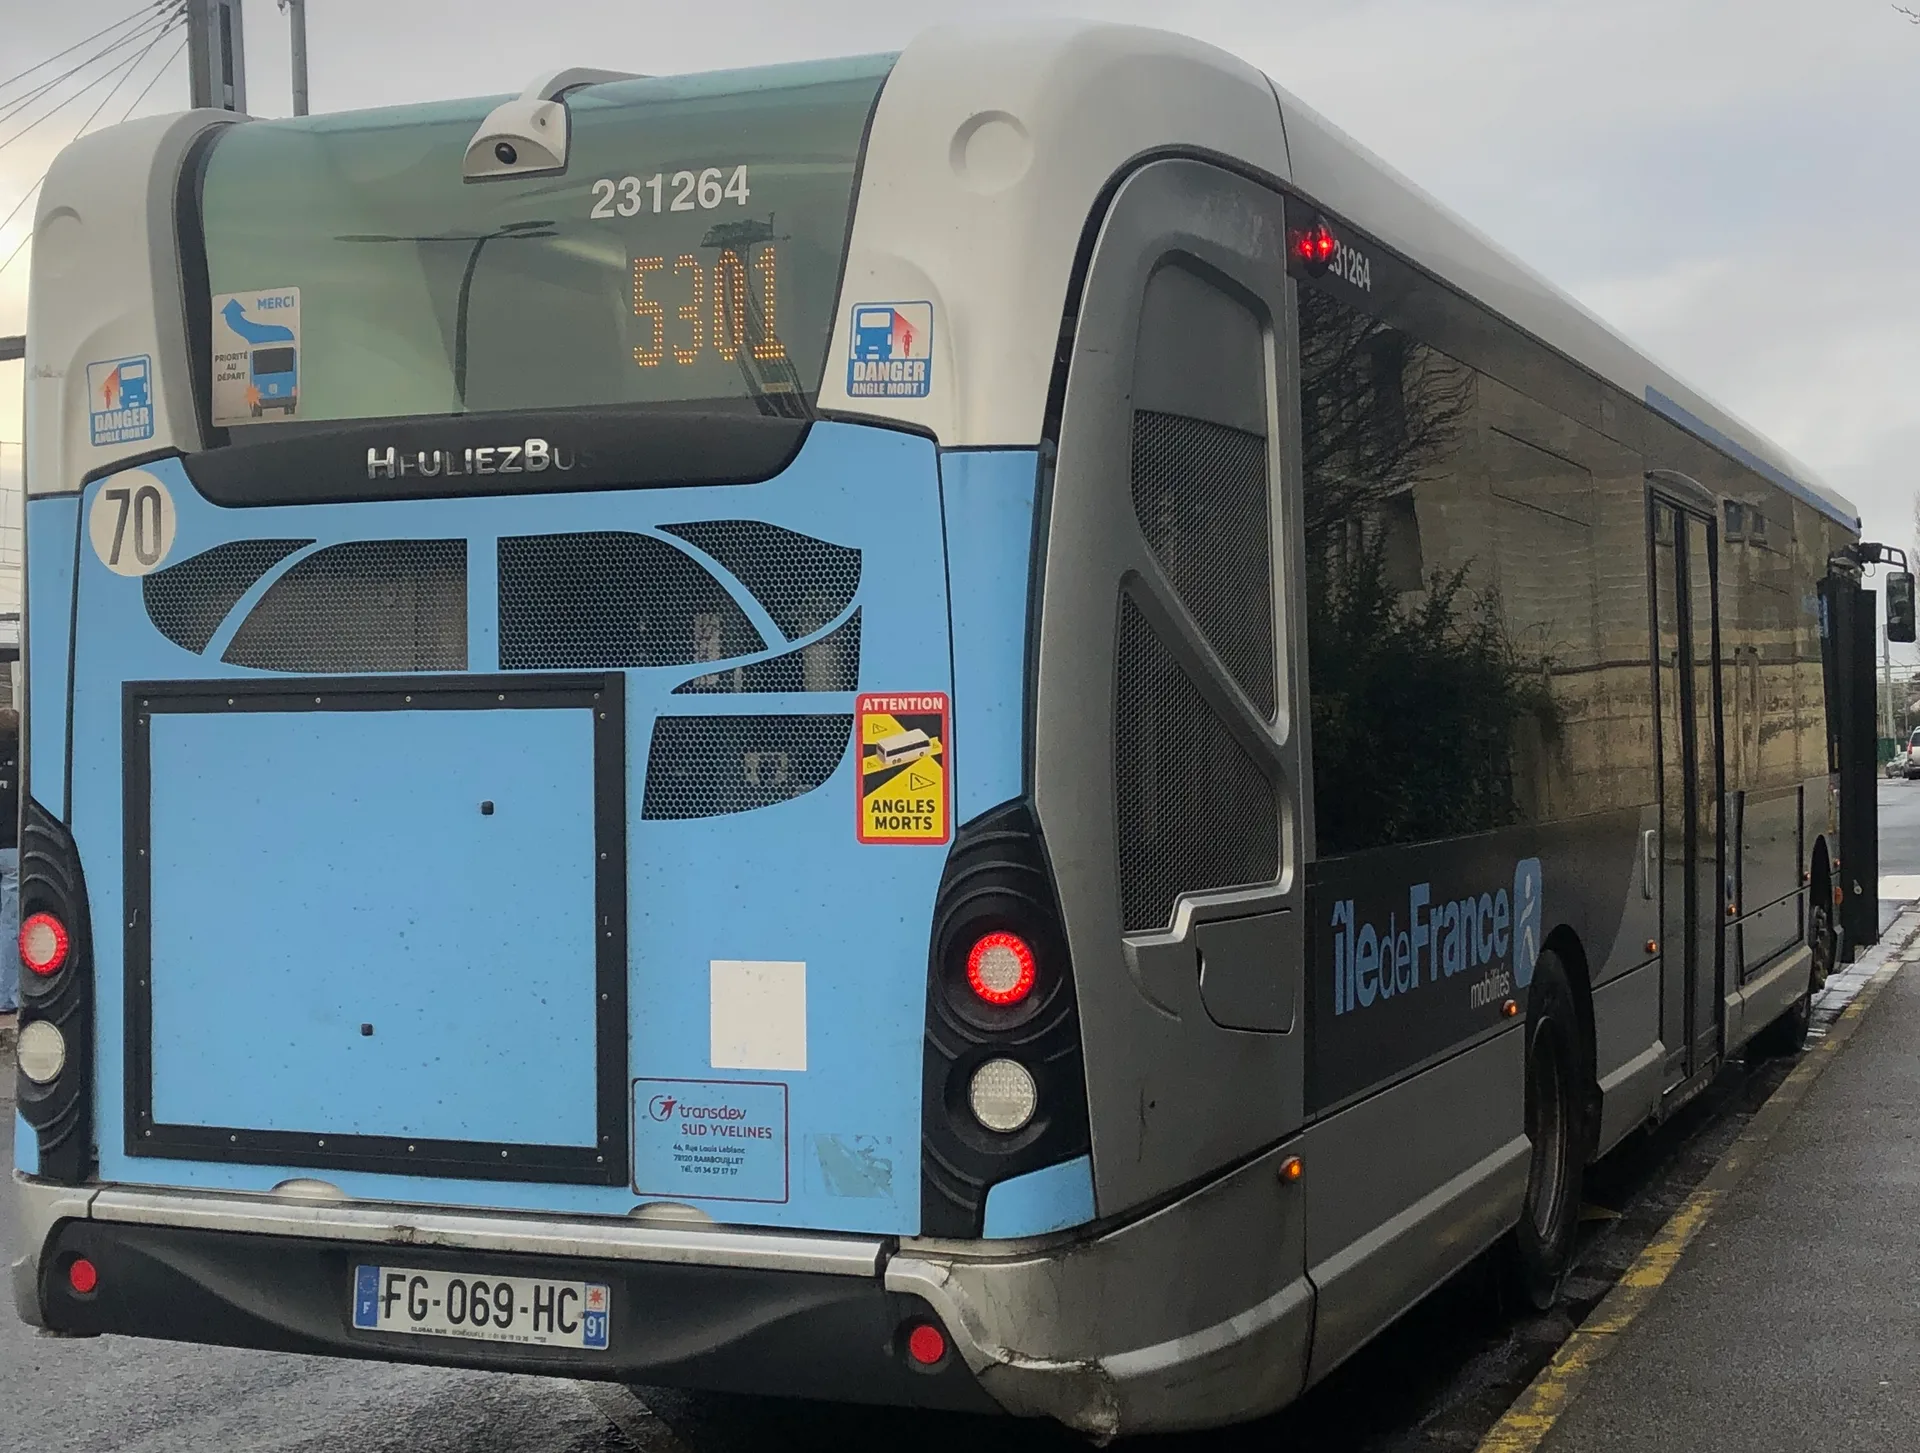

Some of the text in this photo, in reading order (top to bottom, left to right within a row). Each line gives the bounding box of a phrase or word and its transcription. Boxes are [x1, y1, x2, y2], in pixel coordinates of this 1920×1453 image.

[590, 165, 750, 219] 231264
[1328, 240, 1371, 292] 31264
[256, 296, 294, 310] MERCI
[632, 247, 785, 367] 5301
[214, 351, 248, 362] PRIORITÉ
[226, 363, 237, 371] AU
[853, 361, 925, 381] DANGER
[217, 371, 246, 381] DÉPART
[852, 383, 885, 395] ANGLE
[887, 383, 919, 394] MORT
[94, 407, 149, 432] DANGER
[122, 426, 145, 440] MORT
[106, 485, 162, 566] 70
[863, 697, 942, 711] ATTENTION
[871, 799, 935, 813] ANGLES
[875, 816, 933, 830] MORTS
[1470, 962, 1510, 1010] mobilités
[678, 1104, 747, 1120] transdev
[681, 1124, 772, 1139] SUD YVELINES
[685, 1144, 698, 1152] Rue
[700, 1145, 718, 1153] Louis
[719, 1146, 746, 1154] Leblanc
[694, 1156, 744, 1165] RAMBOUILLET
[363, 1302, 370, 1314] F
[384, 1273, 579, 1334] FG-069-HC
[587, 1316, 605, 1339] 91
